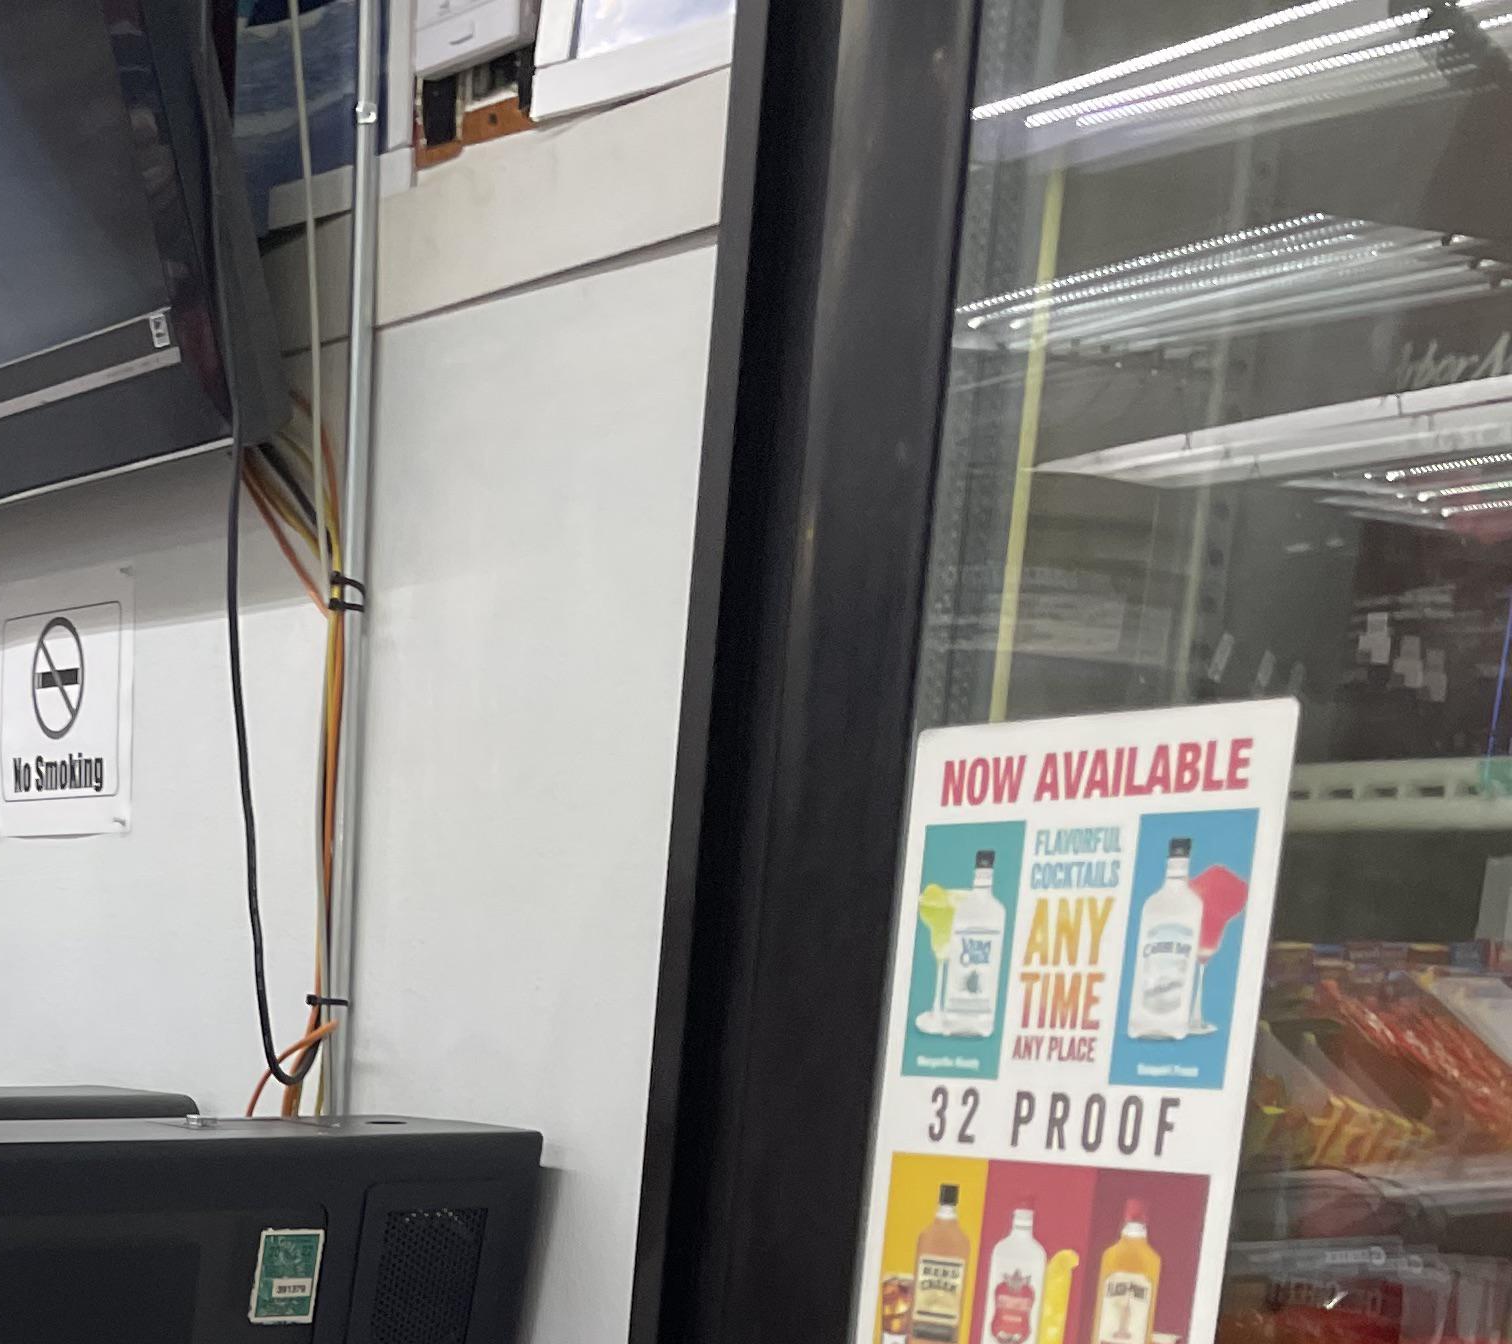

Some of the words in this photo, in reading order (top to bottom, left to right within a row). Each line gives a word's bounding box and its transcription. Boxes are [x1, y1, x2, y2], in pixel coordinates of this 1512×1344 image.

[13, 757, 31, 793] No
[35, 752, 104, 793] Smoking
[940, 755, 1027, 807] NOW
[1034, 738, 1254, 803] AVAILABLE
[1034, 826, 1121, 856] FLAVORFUL
[1030, 860, 1121, 890] COCKTAILS
[1023, 896, 1115, 967] ANY
[1020, 972, 1106, 1031] TIME
[1012, 1035, 1044, 1061] ANY
[1048, 1036, 1097, 1063] PLACE
[929, 1084, 980, 1144] 32
[1010, 1090, 1181, 1157] PROOF
